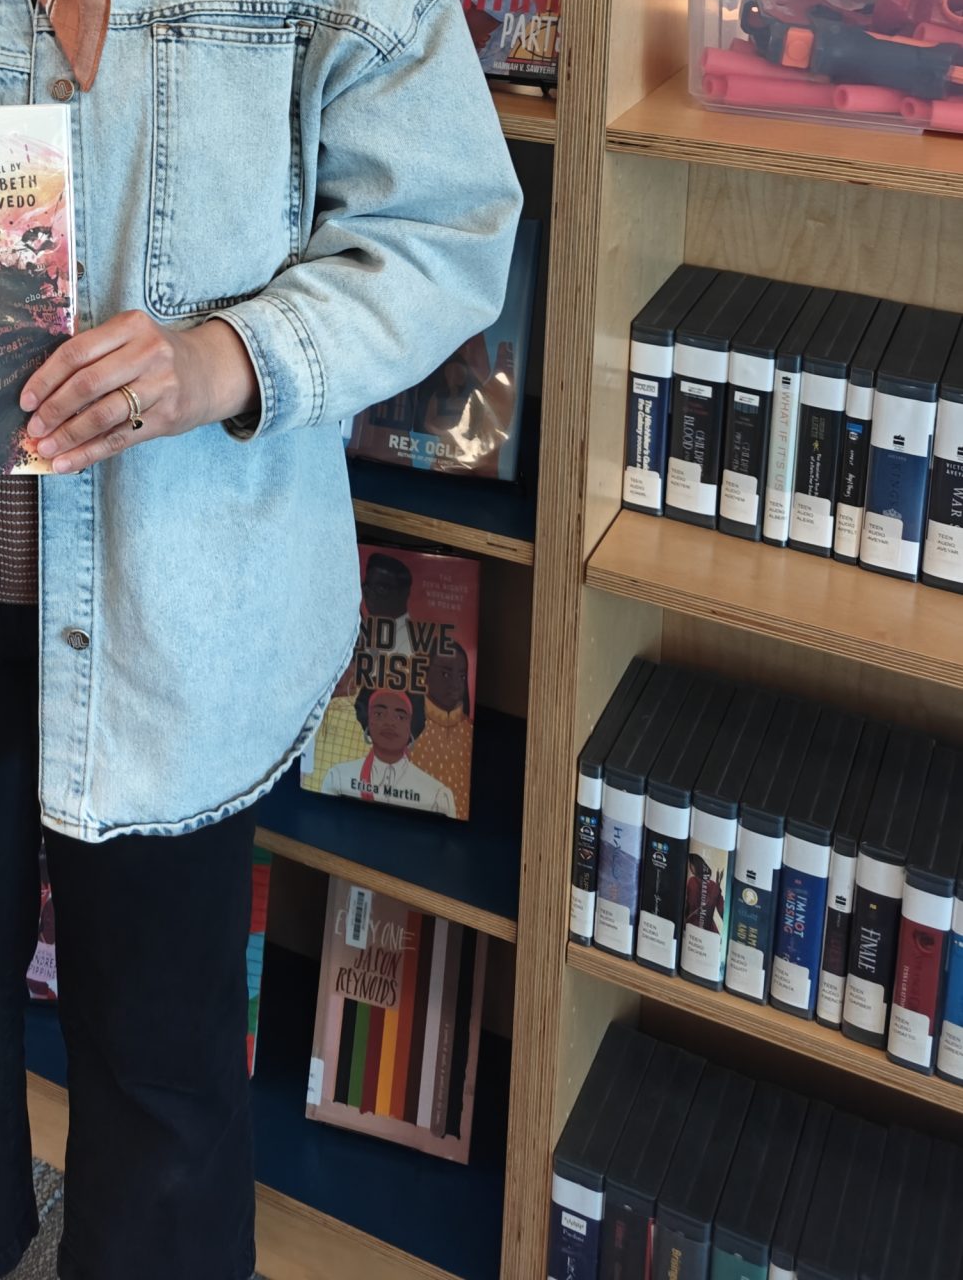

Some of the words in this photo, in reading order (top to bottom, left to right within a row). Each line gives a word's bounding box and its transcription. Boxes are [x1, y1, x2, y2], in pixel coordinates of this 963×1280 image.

[493, 61, 519, 71] HANNAH
[10, 162, 21, 172] BY
[645, 399, 653, 413] The
[780, 392, 791, 426] WHAT
[682, 415, 695, 450] BLOOD
[779, 429, 787, 442] IF
[389, 434, 419, 452] REX
[425, 441, 462, 458] OGLE
[725, 480, 739, 488] TEEN
[725, 487, 741, 495] AUDIO
[773, 474, 784, 492] US
[950, 487, 963, 517] WAR
[868, 530, 885, 538] AUDIO
[869, 523, 884, 531] TEEN
[937, 540, 956, 548] AUDIO
[938, 532, 954, 541] TEEN
[357, 617, 395, 650] ND
[406, 620, 456, 658] WE
[356, 651, 429, 694] RISE
[350, 777, 379, 794] Erica
[383, 784, 421, 802] Martin
[795, 895, 807, 913] I'M
[783, 891, 795, 934] MISSING
[643, 920, 657, 930] TEEN
[794, 914, 806, 939] NOT
[381, 920, 416, 951] ONE
[857, 925, 881, 974] FINALE
[353, 945, 403, 979] JASON
[335, 967, 398, 1007] REYNOLDS
[822, 982, 838, 992] TEEN
[822, 989, 840, 998] AUDIO
[849, 984, 864, 995] TEEN
[946, 1032, 961, 1043] TEEN
